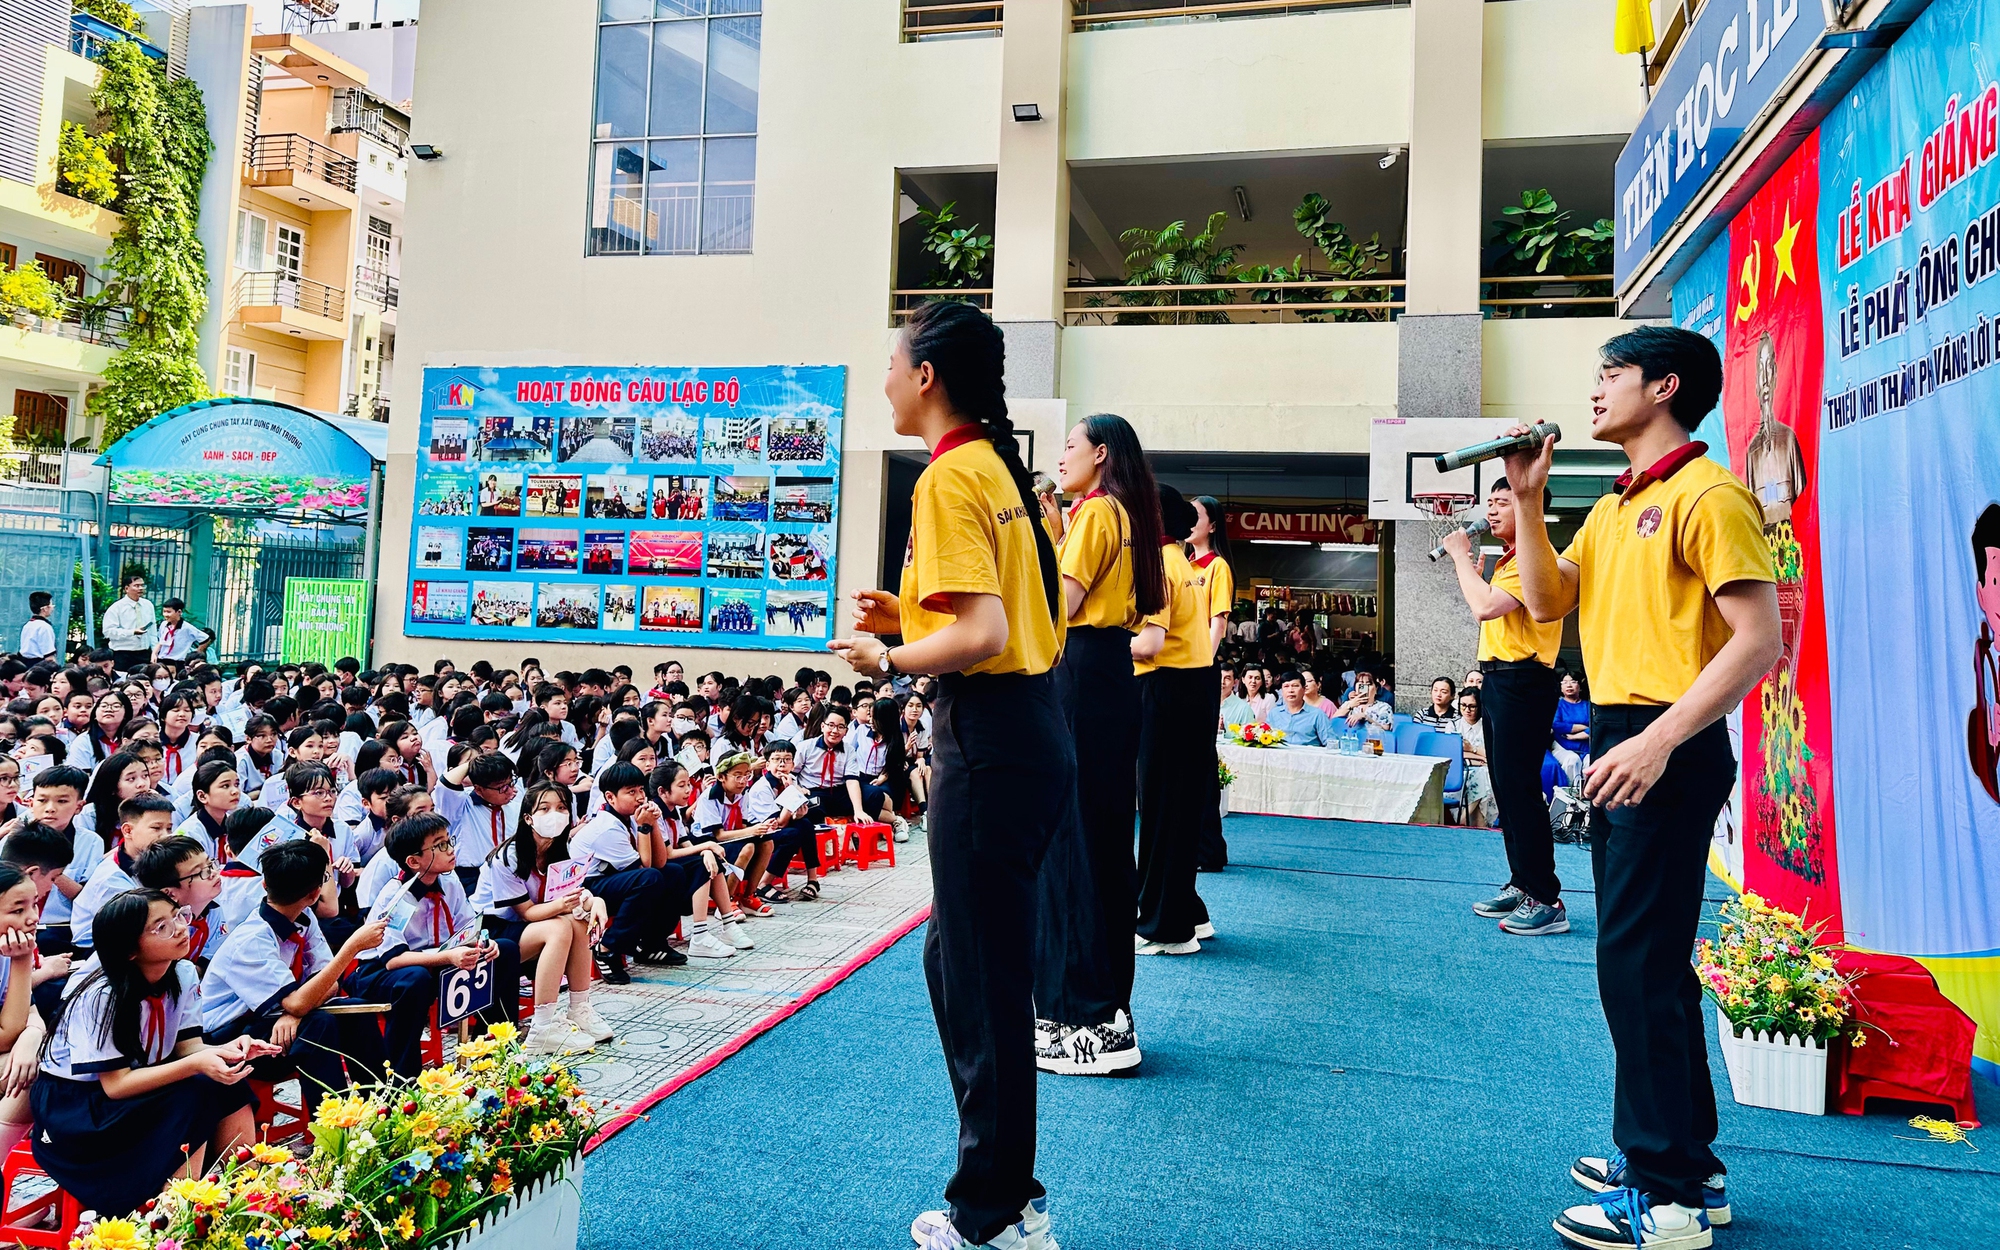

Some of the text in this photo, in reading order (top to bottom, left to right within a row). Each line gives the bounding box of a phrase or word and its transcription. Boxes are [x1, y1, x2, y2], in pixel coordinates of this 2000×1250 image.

[1622, 122, 1671, 253] TIÊN
[1675, 13, 1739, 183] HỌC
[1839, 182, 1862, 269] LỄ
[1919, 86, 1997, 208] GIẢNG
[1840, 287, 1860, 358] LỄ
[1864, 270, 1910, 346] PHÁT
[1965, 206, 2000, 285] CH
[1860, 380, 1878, 419] NHI
[1933, 335, 1968, 387] VÂNG
[1970, 316, 1990, 370] LỜI
[438, 383, 474, 406] HKN
[517, 377, 740, 407] HOẠT ĐỘNG CÂU LẠC BỘ
[209, 418, 229, 430] CHUNG
[230, 417, 240, 426] TAY
[203, 450, 225, 460] XANH
[231, 451, 254, 463] SẠCH
[261, 451, 277, 463] ĐẸP
[1240, 512, 1291, 531] CAN
[1296, 513, 1336, 532] TIN
[316, 594, 341, 604] CHUNG
[447, 960, 488, 1017] 6 5
